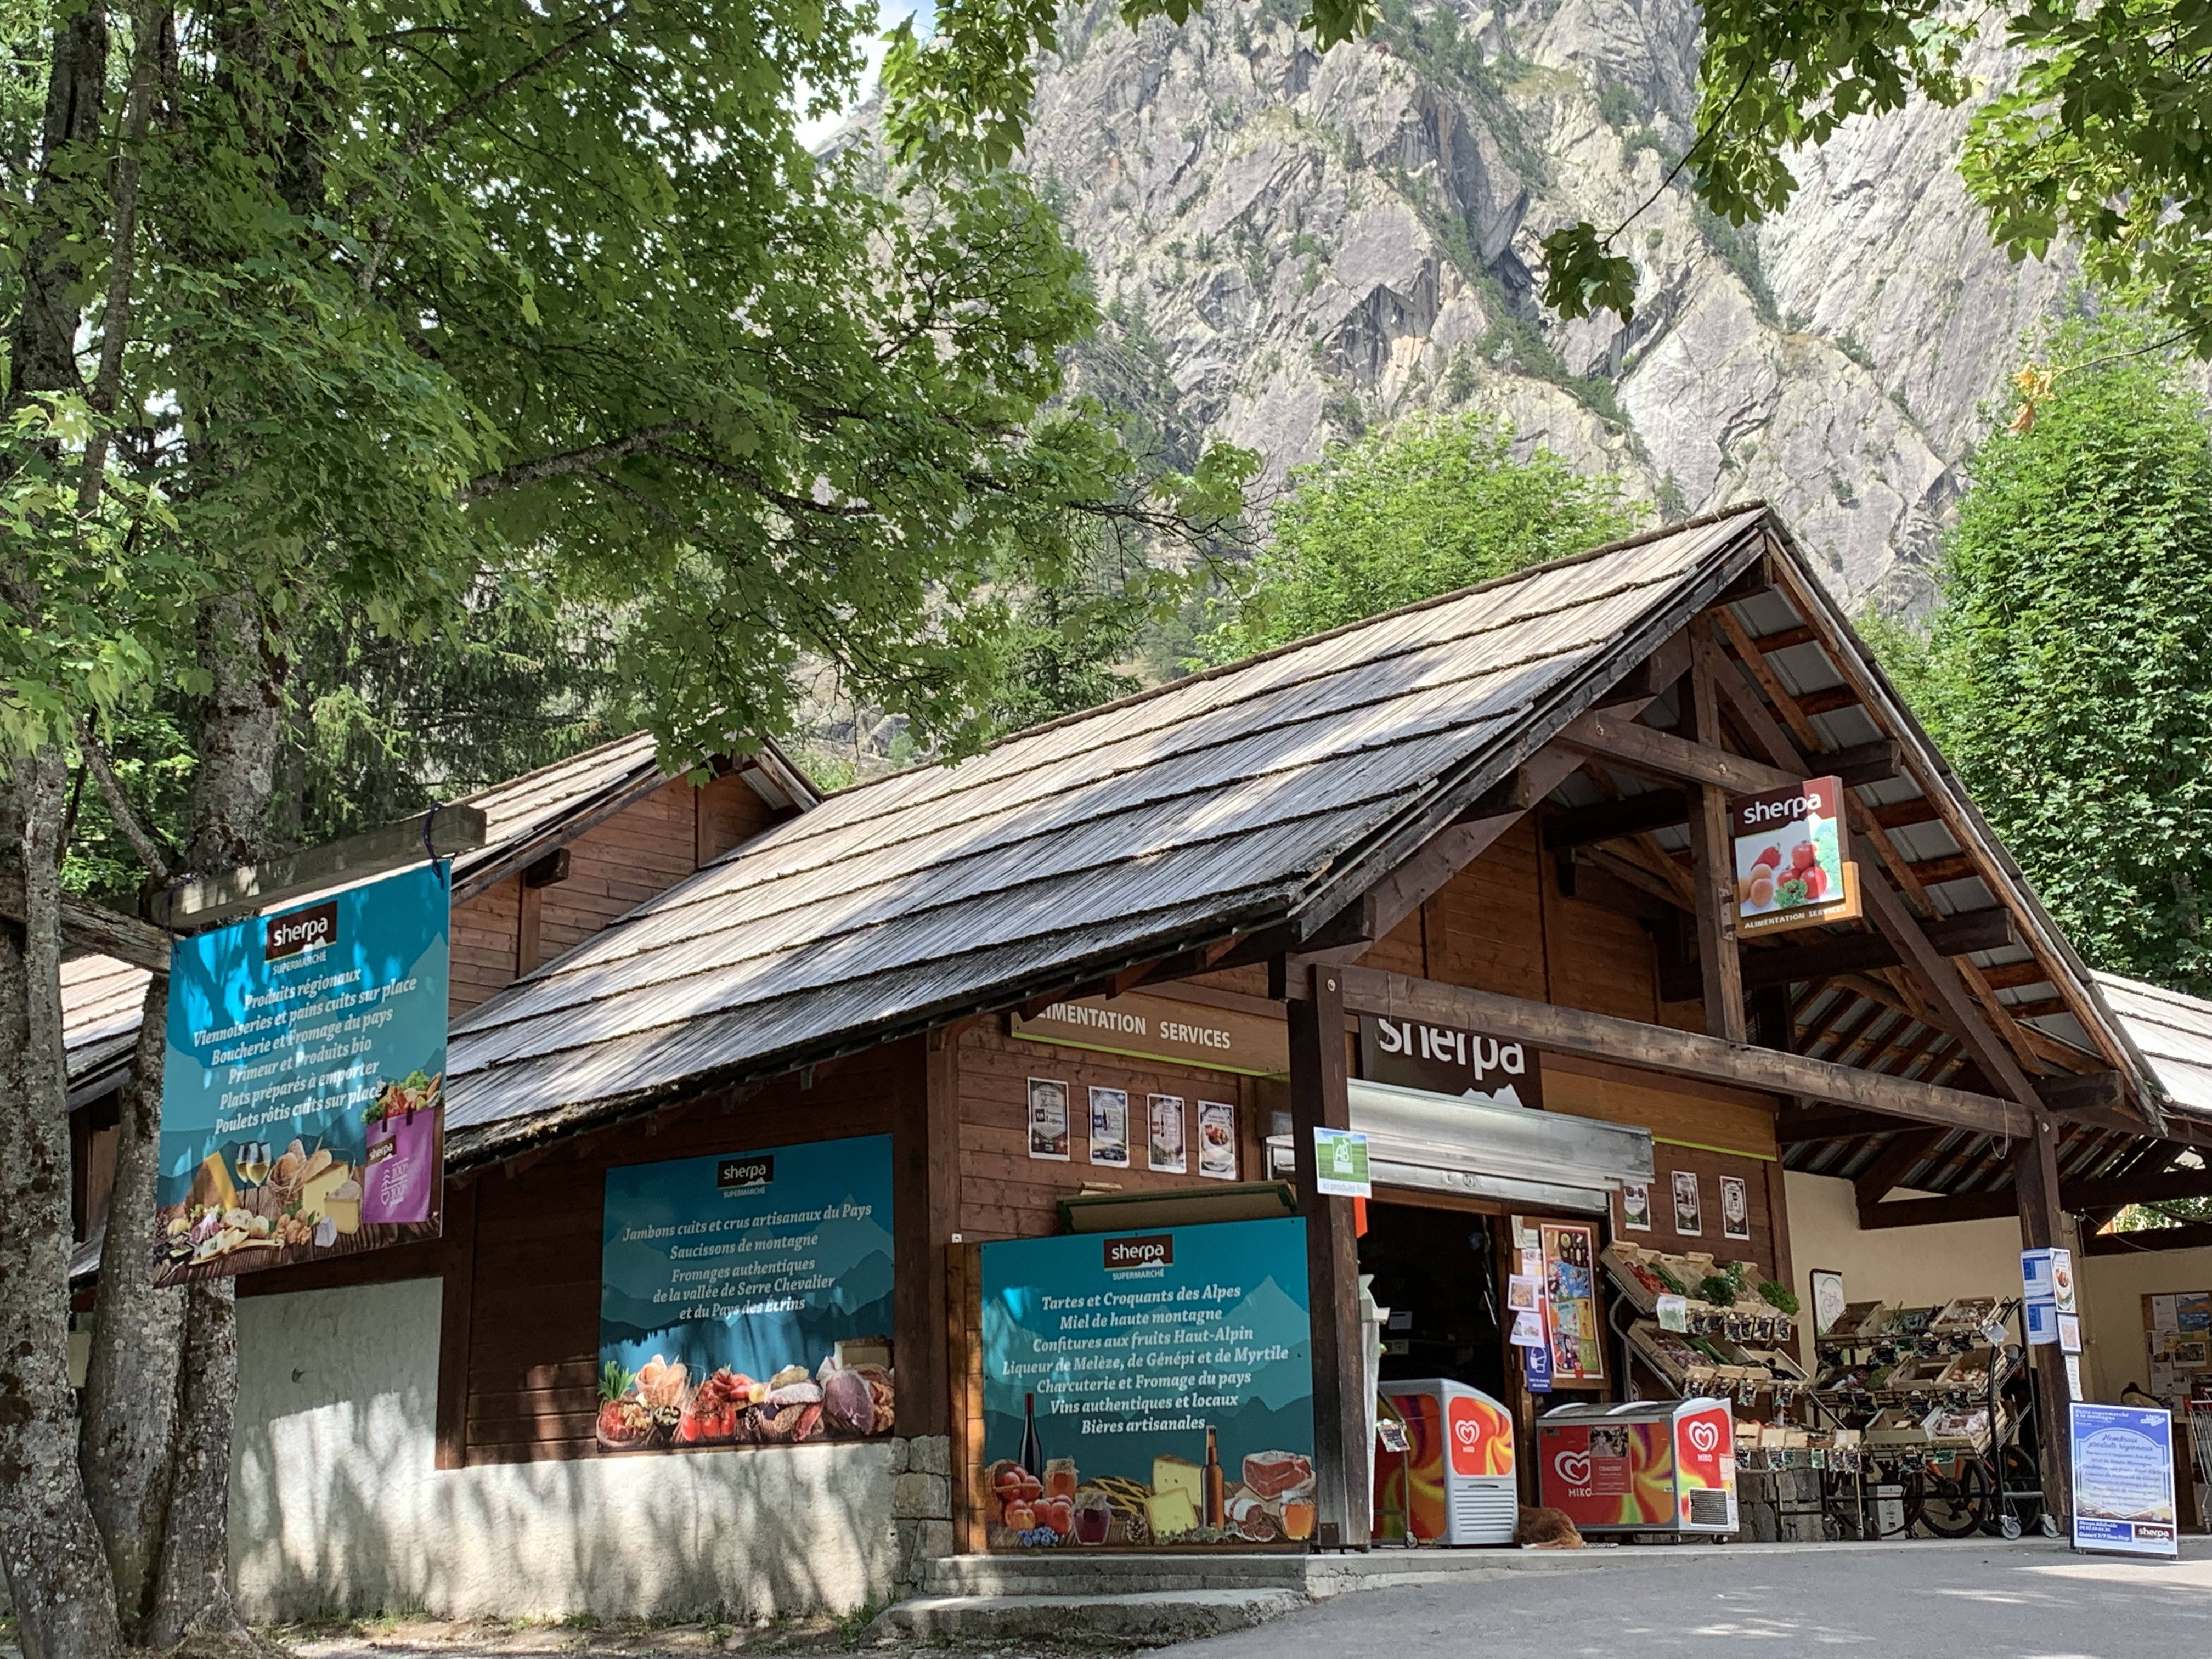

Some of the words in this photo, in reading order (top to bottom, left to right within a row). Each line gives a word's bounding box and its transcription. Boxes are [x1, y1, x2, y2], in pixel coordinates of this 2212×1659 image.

[1743, 793, 1821, 824] sherpa
[1745, 913, 1805, 929] ALIMENTATION
[1808, 906, 1846, 917] SERVICES
[274, 917, 328, 947] sherpa
[273, 951, 326, 976] SUPERMARCHÉ
[244, 988, 295, 1011] Produits
[298, 969, 360, 997] régionaux
[194, 1014, 273, 1047] Viennoiseries
[276, 1012, 287, 1024] et
[289, 1001, 323, 1028] pains
[325, 992, 357, 1013] cuits
[359, 987, 380, 1002] sur
[382, 978, 417, 1003] place
[211, 1037, 272, 1066] Boucherie
[273, 1035, 286, 1048] et
[288, 1019, 342, 1046] Fromage
[345, 1014, 360, 1031] du
[363, 1008, 393, 1032] pays
[1160, 1020, 1231, 1049] SERVICES
[228, 1061, 279, 1085] Primeur
[280, 1058, 292, 1071] et
[295, 1041, 349, 1068] Produits
[351, 1036, 371, 1053] bio
[1378, 1018, 1525, 1081] sherpa
[220, 1088, 250, 1110] Plats
[252, 1075, 306, 1108] préparés
[308, 1073, 315, 1088] à
[318, 1061, 379, 1087] emporter
[215, 1112, 259, 1135] Poulets
[261, 1103, 291, 1124] rôtis
[292, 1096, 323, 1116] cuits
[325, 1092, 346, 1109] sur
[347, 1082, 382, 1109] place
[370, 1143, 393, 1160] sherpa
[1335, 1143, 1350, 1161] AB
[724, 1163, 766, 1180] sherpa
[723, 1186, 765, 1199] SUPERMARCHÉ
[1331, 1183, 1356, 1193] produits
[623, 1225, 675, 1241] Jambons
[677, 1219, 707, 1234] cuits
[709, 1221, 721, 1231] et
[724, 1218, 750, 1229] crus
[752, 1209, 821, 1226] artisanaux
[823, 1206, 839, 1219] du
[842, 1203, 872, 1220] Pays
[670, 1239, 735, 1260] Saucissons
[738, 1238, 752, 1252] de
[755, 1233, 817, 1251] montagne
[1111, 1243, 1164, 1262] sherpa
[672, 1265, 730, 1283] Fromages
[732, 1257, 815, 1279] authentiques
[1112, 1268, 1164, 1280] SUPERMARCHÉ
[653, 1290, 667, 1303] de
[669, 1289, 680, 1301] la
[684, 1284, 718, 1300] vallée
[721, 1284, 735, 1296] de
[738, 1280, 771, 1296] Serre
[775, 1274, 835, 1292] Chevalier
[1042, 1295, 1084, 1311] Tartes
[1087, 1295, 1102, 1307] et
[1104, 1290, 1173, 1311] Croquants
[1176, 1286, 1199, 1301] des
[1202, 1284, 1241, 1304] Alpes
[680, 1308, 692, 1319] et
[695, 1304, 709, 1318] du
[713, 1302, 740, 1321] Pays
[742, 1299, 763, 1314] des
[765, 1294, 805, 1313] Écrins
[1060, 1316, 1089, 1330] Miel
[1092, 1313, 1107, 1328] de
[1110, 1311, 1149, 1327] haute
[1153, 1308, 1222, 1328] montagne
[1033, 1336, 1102, 1353] Confitures
[1104, 1336, 1129, 1348] aux
[1131, 1331, 1171, 1349] fruits
[1173, 1327, 1254, 1345] Haut-Alpin
[1002, 1362, 1052, 1378] Liqueur
[1056, 1358, 1071, 1372] de
[1074, 1354, 1125, 1372] Melèze,
[1127, 1354, 1143, 1368] de
[1147, 1350, 1195, 1370] Génépi
[1198, 1351, 1211, 1364] et
[1215, 1348, 1232, 1363] de
[1234, 1345, 1288, 1364] Myrtile
[1037, 1376, 1115, 1393] Charcuterie
[1119, 1376, 1133, 1389] et
[1135, 1370, 1195, 1391] Fromage
[1198, 1372, 1216, 1386] du
[1218, 1372, 1251, 1388] pays
[1051, 1400, 1079, 1415] Vins
[1082, 1394, 1172, 1414] authentiques
[1176, 1396, 1189, 1408] et
[1192, 1393, 1238, 1407] locaux
[1082, 1418, 1123, 1434] Bières
[1126, 1415, 1205, 1432] artisanales
[1697, 1454, 1712, 1462] MIKO
[1568, 1488, 1591, 1497] MIKO
[2138, 1527, 2169, 1537] sherpa
